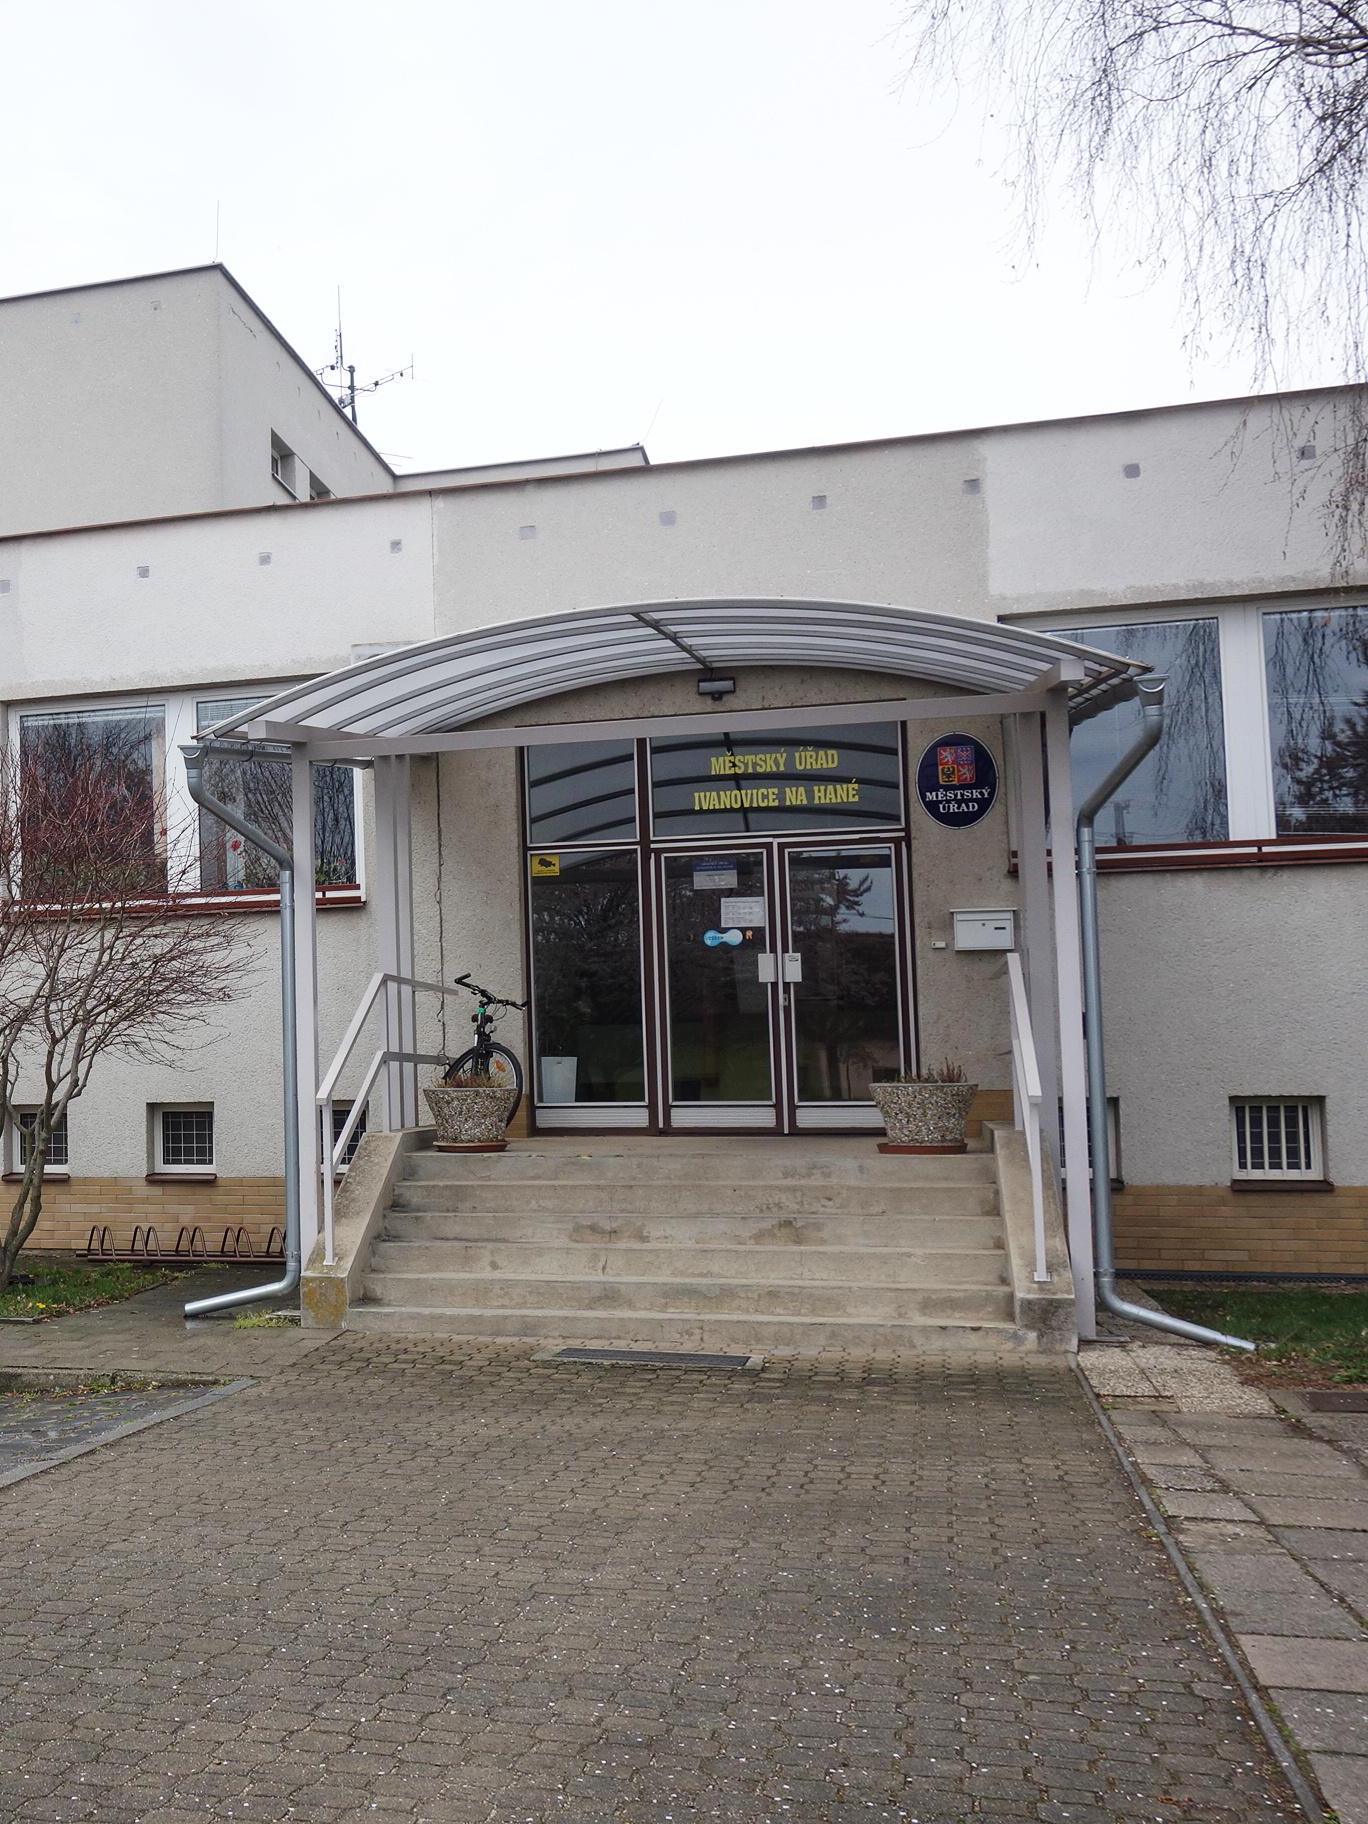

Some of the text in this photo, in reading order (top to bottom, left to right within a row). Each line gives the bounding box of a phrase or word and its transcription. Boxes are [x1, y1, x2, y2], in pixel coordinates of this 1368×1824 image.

[711, 746, 839, 775] MĚSTSKÝ ÚŘAD
[694, 778, 859, 811] IVANOVICE NA HANÉ
[925, 786, 991, 801] MĚSTSKÝ
[939, 800, 979, 813] ÚŘAD
